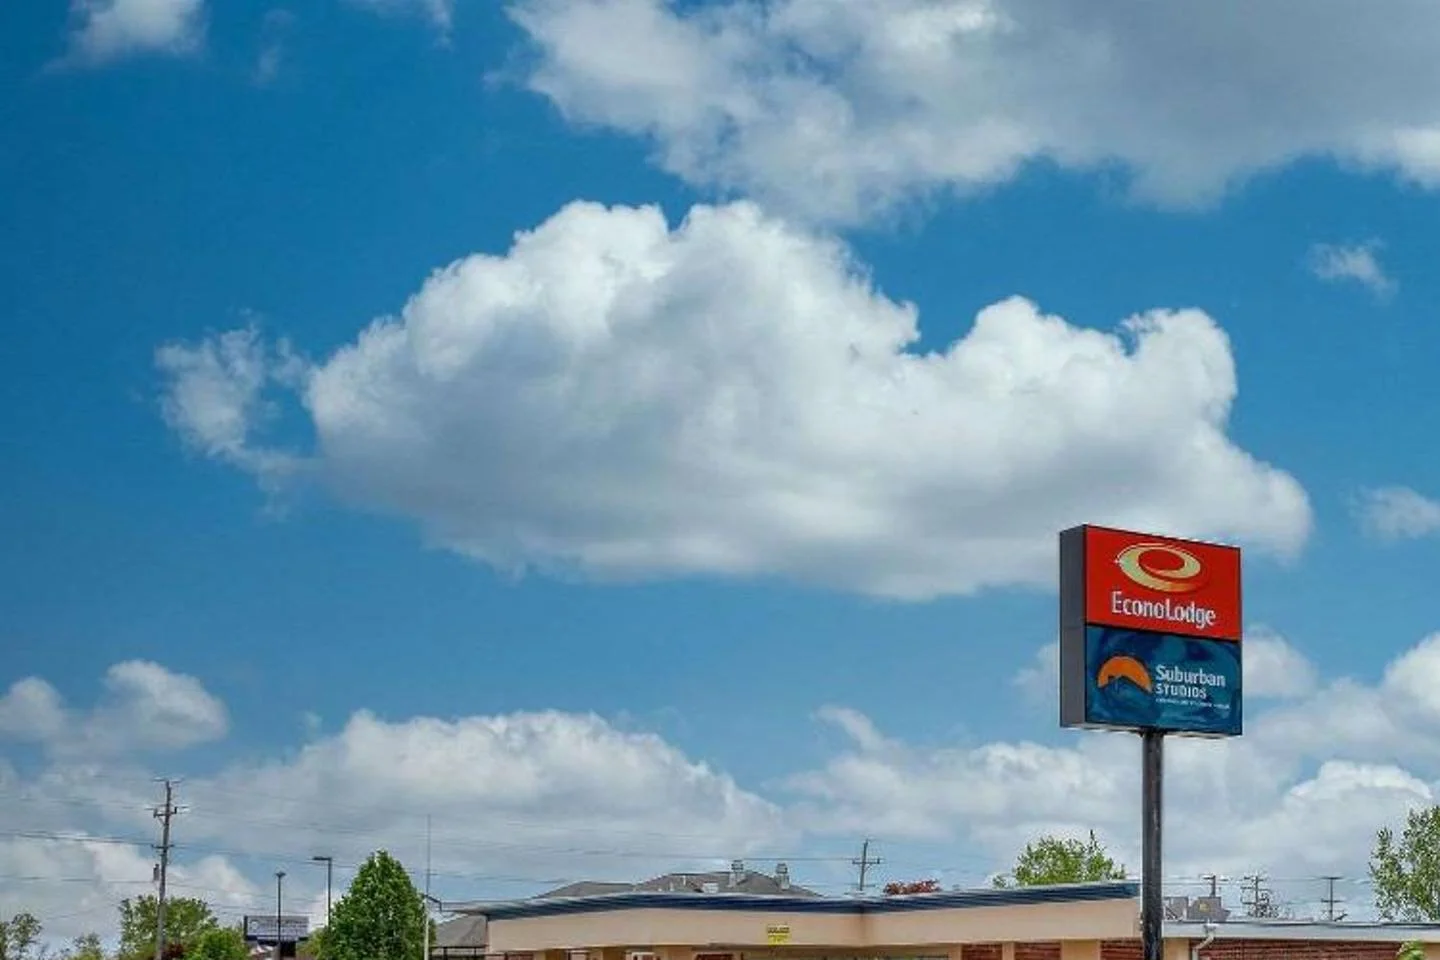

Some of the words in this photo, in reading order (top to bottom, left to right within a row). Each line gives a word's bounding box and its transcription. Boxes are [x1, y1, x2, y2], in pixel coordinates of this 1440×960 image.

[1111, 590, 1216, 629] EconoLodge
[1155, 664, 1226, 687] Suburban
[1155, 683, 1207, 700] STUDIOS
